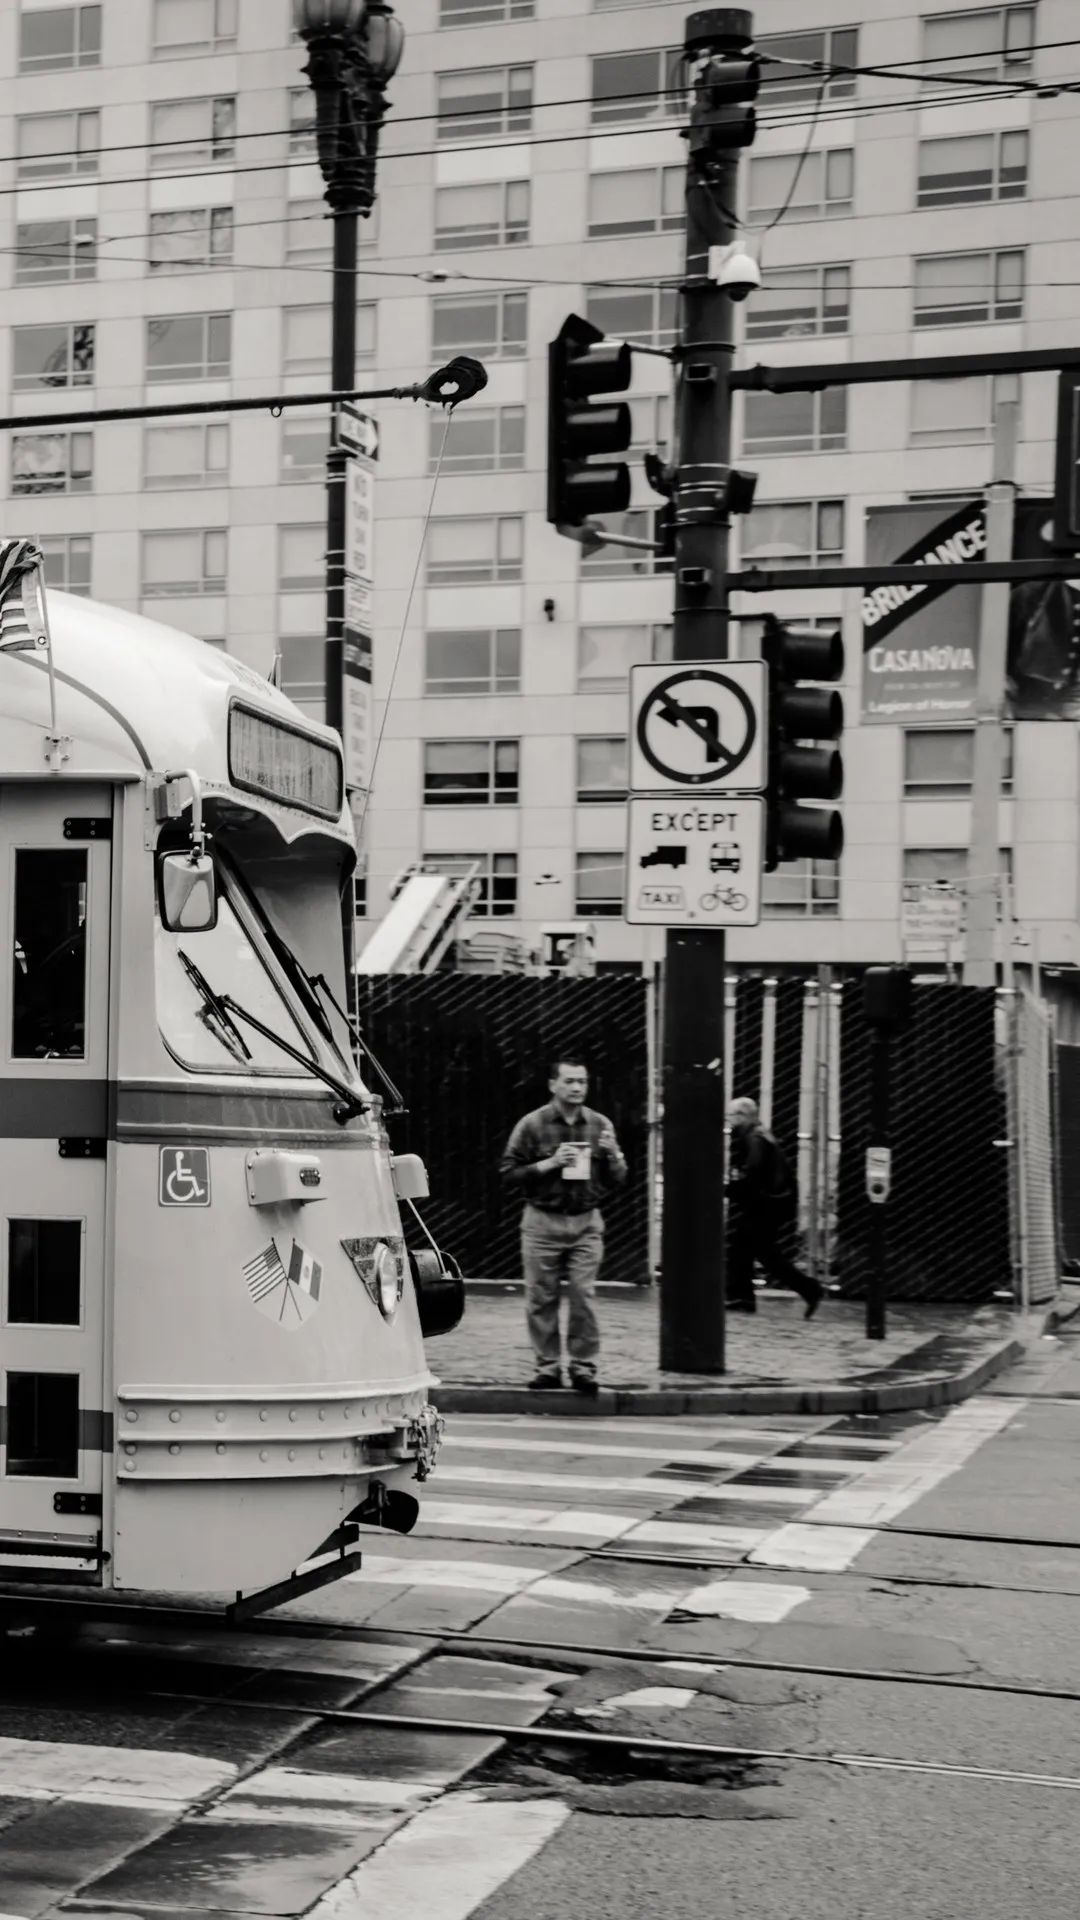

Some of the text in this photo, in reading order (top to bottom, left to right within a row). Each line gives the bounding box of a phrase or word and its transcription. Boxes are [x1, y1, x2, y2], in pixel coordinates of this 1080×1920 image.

[862, 520, 986, 625] BRILNCE
[652, 813, 738, 831] EXCEPT
[643, 892, 680, 904] TAXI
